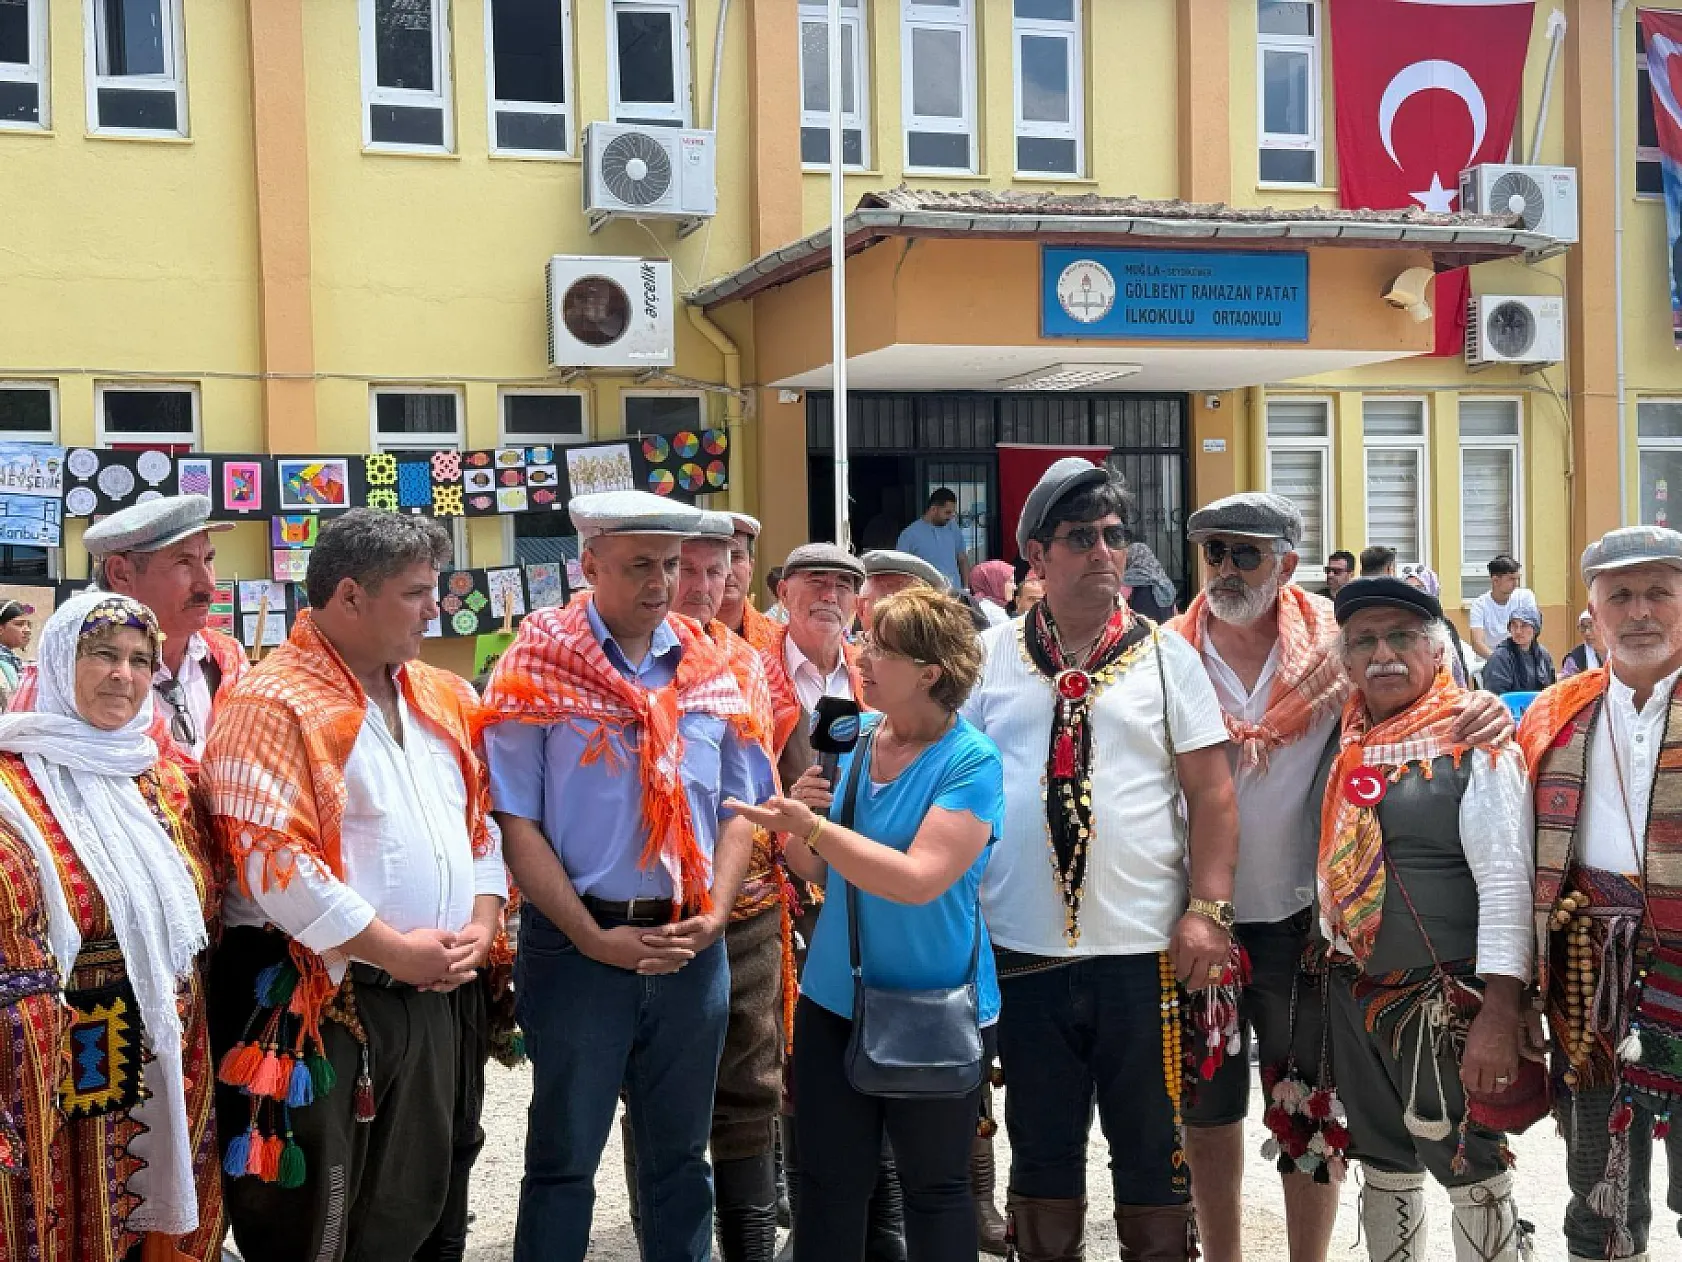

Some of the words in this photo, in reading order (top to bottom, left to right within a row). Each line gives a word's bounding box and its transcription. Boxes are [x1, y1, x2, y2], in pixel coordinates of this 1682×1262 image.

[1125, 263, 1160, 276] MUĞLA
[640, 262, 659, 319] arçelik
[1125, 279, 1187, 299] GÖLBENT
[1191, 284, 1252, 300] RAMAZAN
[1256, 286, 1298, 301] PATAT
[1125, 304, 1195, 324] İLKOKULU
[1213, 310, 1282, 326] ORTAOKULU
